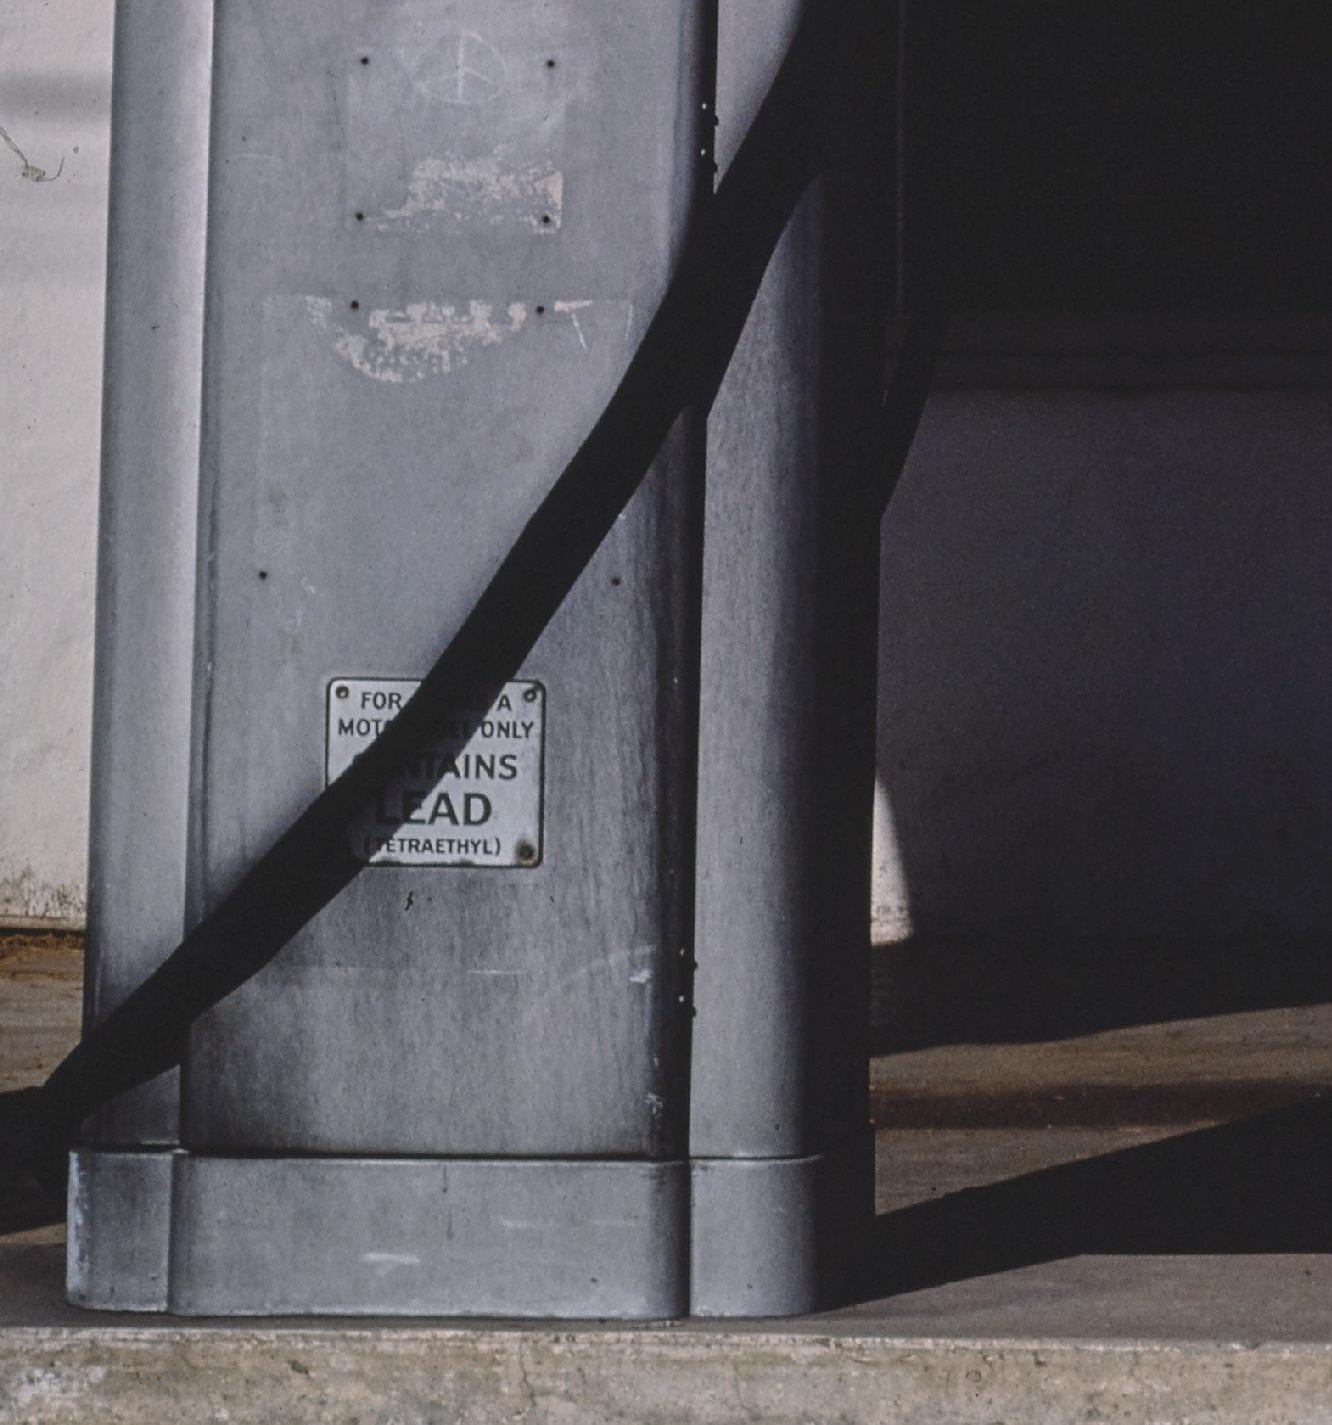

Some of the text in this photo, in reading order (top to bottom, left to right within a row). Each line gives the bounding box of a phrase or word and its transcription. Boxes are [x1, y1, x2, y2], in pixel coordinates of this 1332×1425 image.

[360, 692, 403, 710] FOR
[495, 695, 512, 711] A
[338, 718, 388, 737] MOT
[481, 720, 534, 739] ONLY
